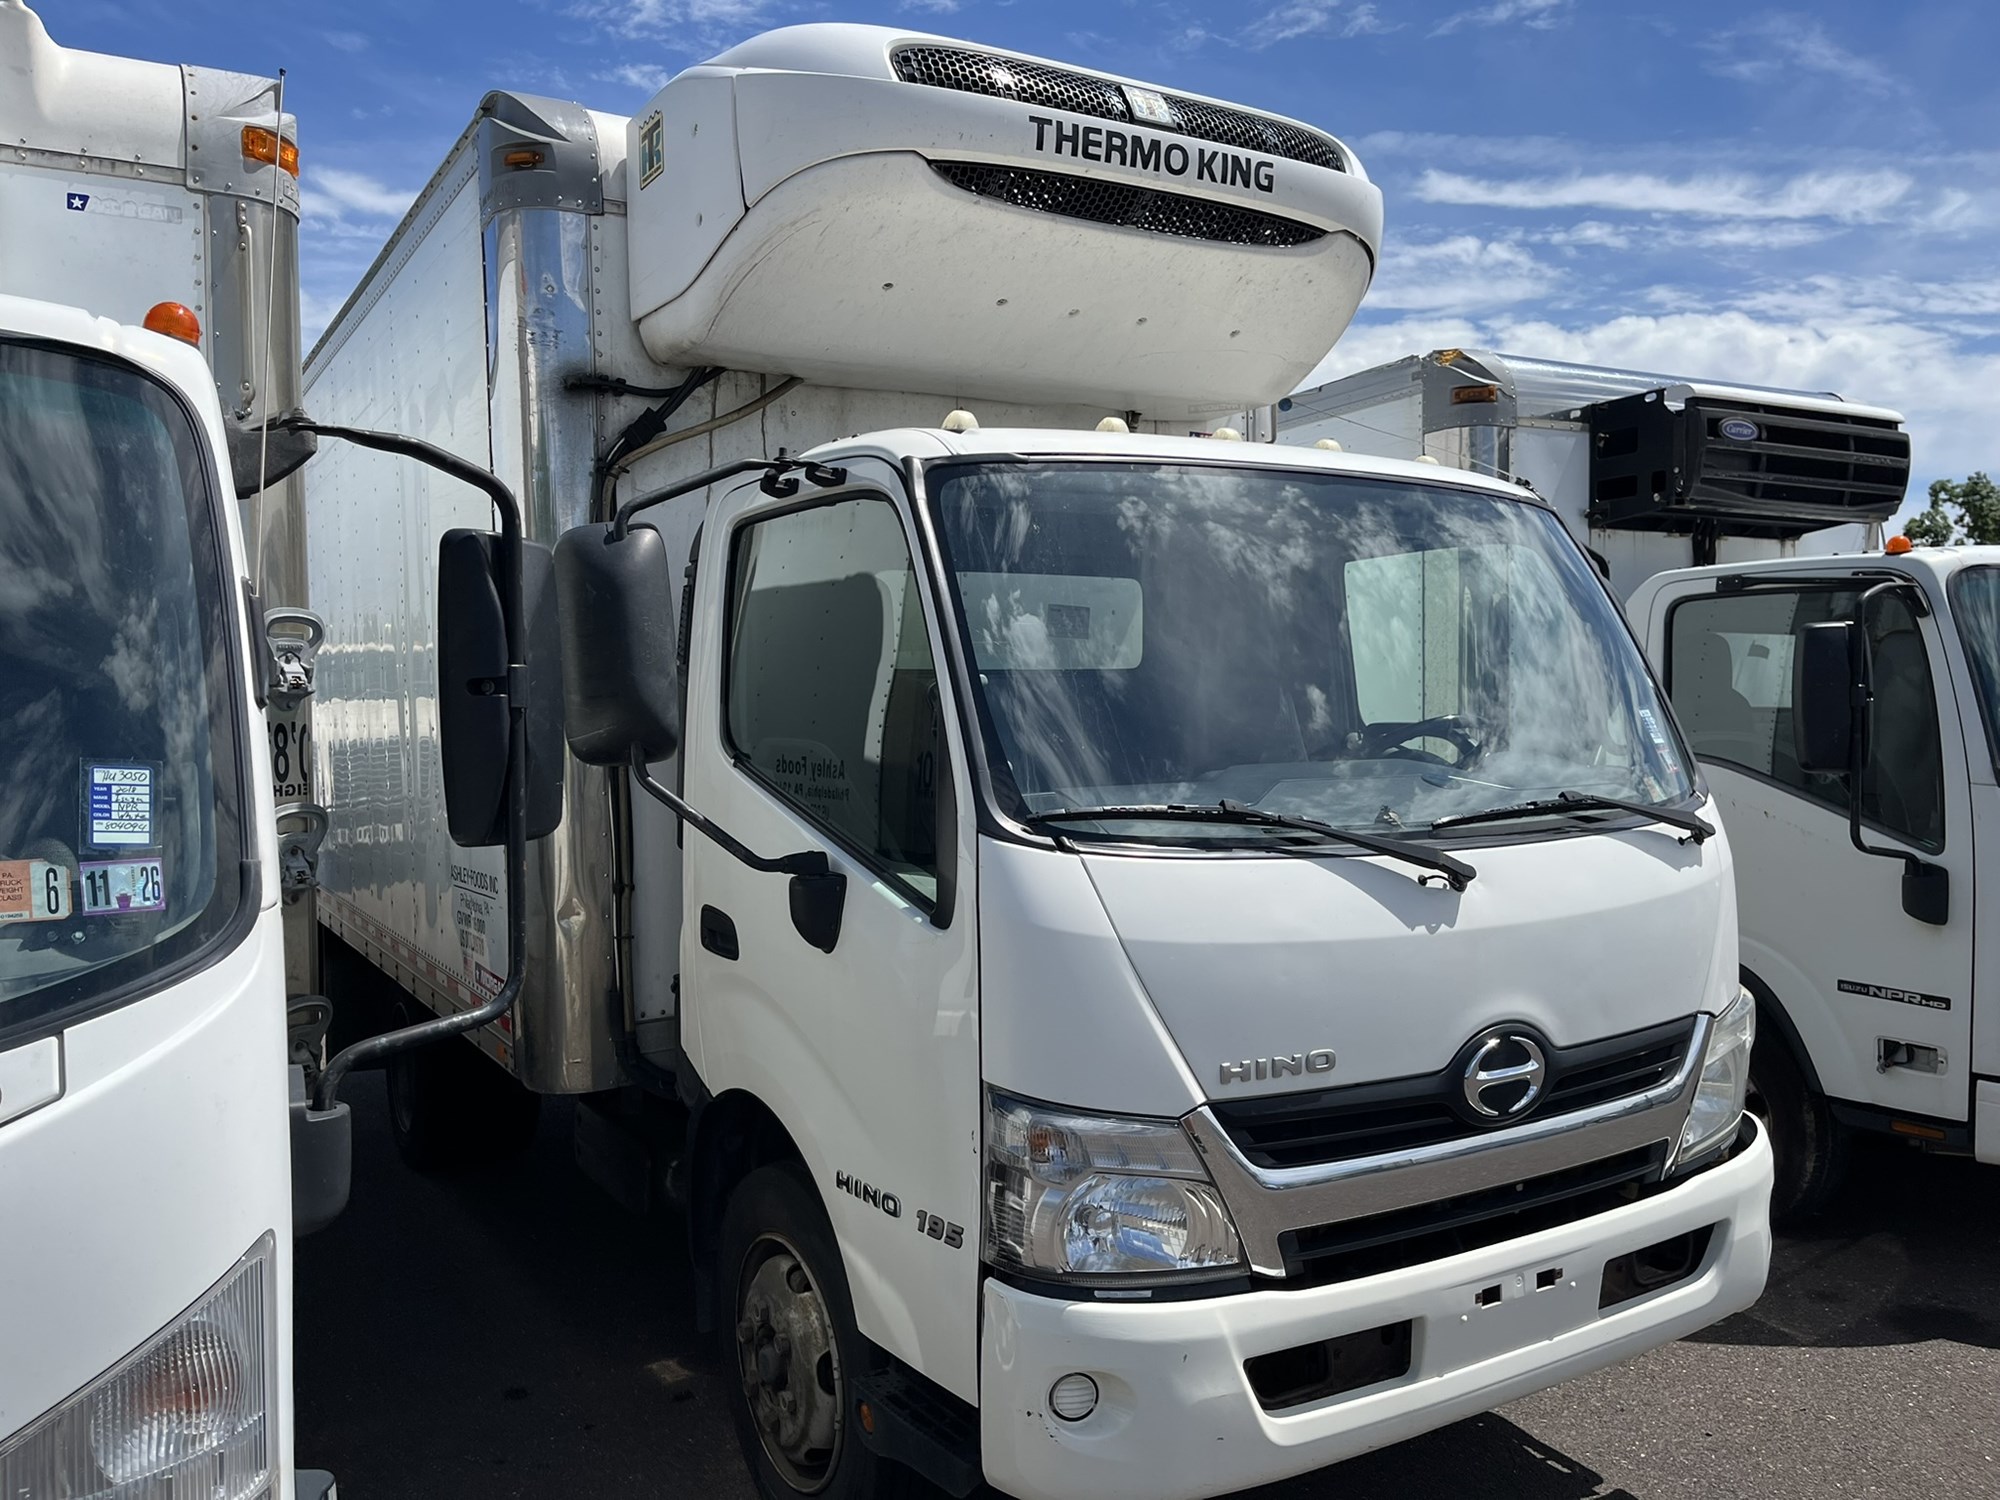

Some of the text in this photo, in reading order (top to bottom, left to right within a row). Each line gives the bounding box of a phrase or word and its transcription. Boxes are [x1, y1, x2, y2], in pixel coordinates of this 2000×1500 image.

[1028, 115, 1275, 193] THERMO KING
[0, 878, 22, 886] RUCK
[45, 867, 60, 915] 6
[86, 869, 111, 907] 11
[140, 865, 161, 901] 26
[1840, 983, 1947, 1009] ISUZU NPR HD
[1219, 1048, 1336, 1085] HINO
[836, 1169, 965, 1249] HINO 195
